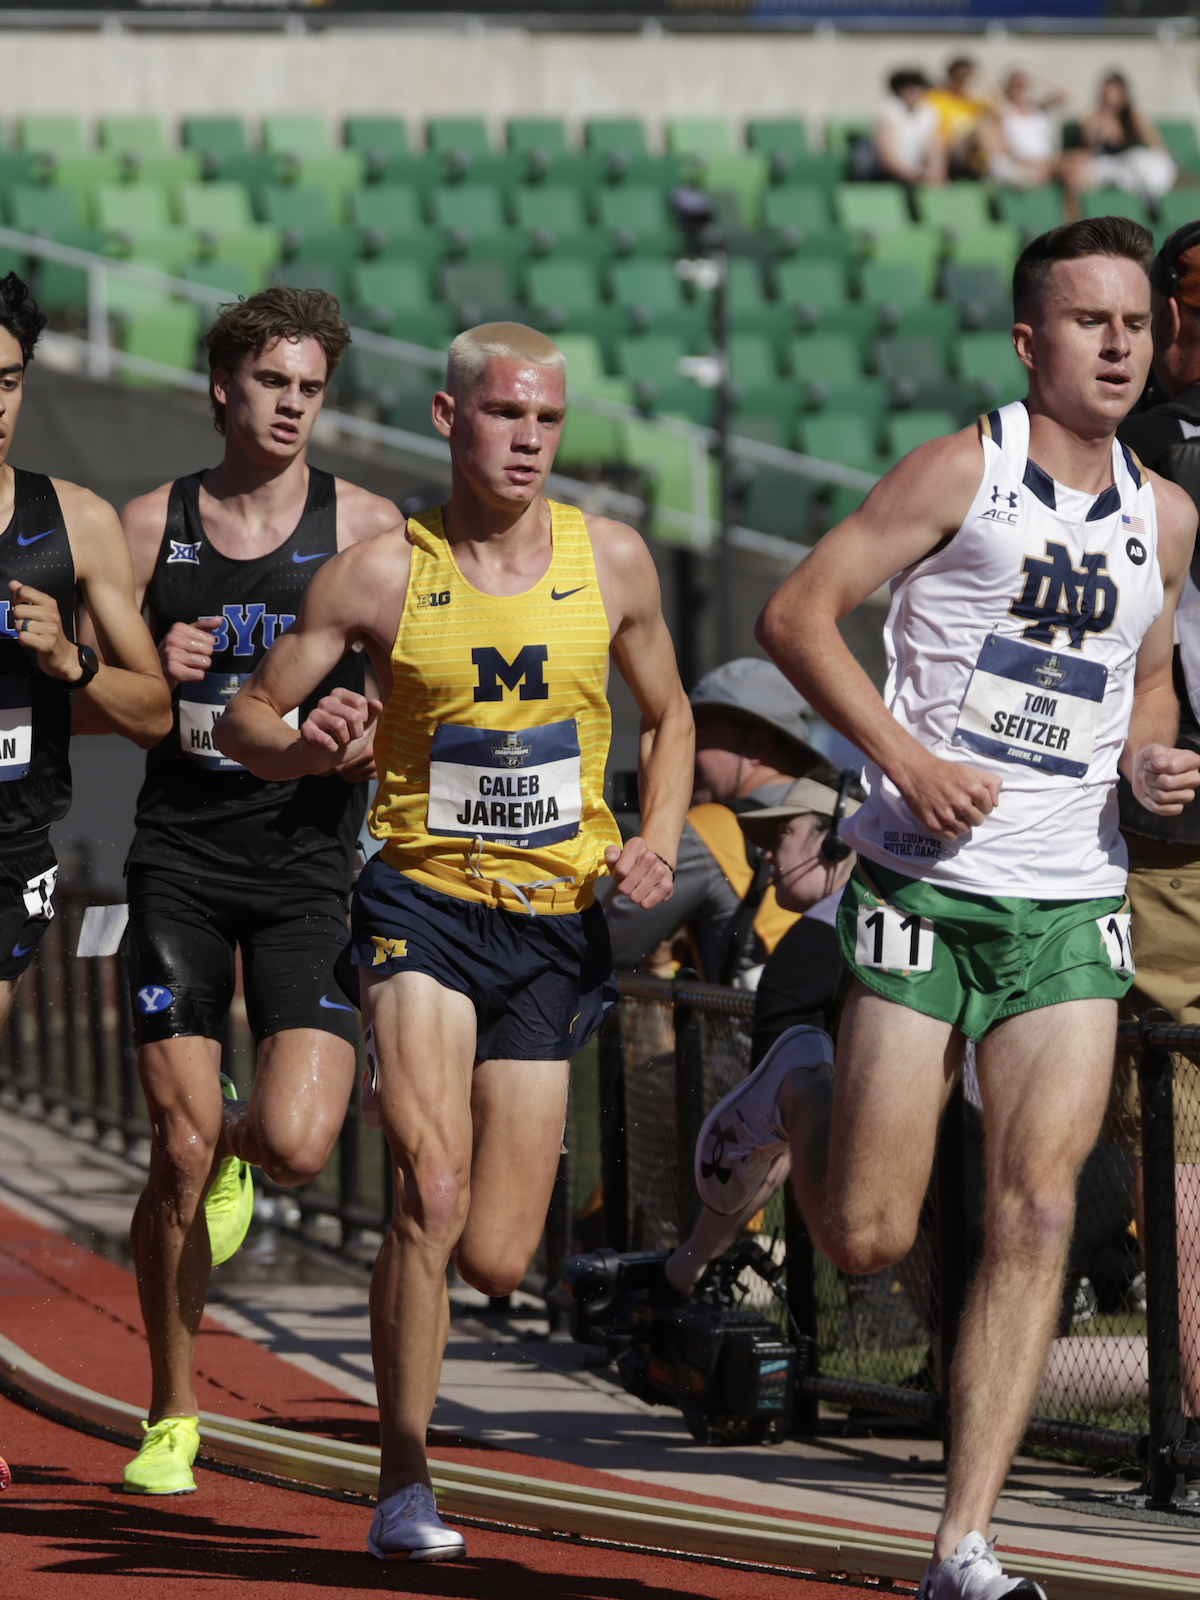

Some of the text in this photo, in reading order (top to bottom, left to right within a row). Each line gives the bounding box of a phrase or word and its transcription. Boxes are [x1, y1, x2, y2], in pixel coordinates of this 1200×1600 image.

[981, 508, 1019, 523] ACC
[170, 543, 200, 562] XII
[1129, 544, 1144, 558] AB
[471, 644, 548, 703] M
[1023, 692, 1058, 717] TOM
[191, 728, 216, 751] HA
[990, 711, 1071, 751] SEITZER
[479, 774, 540, 797] CALEB
[456, 796, 560, 829] JAREMA
[914, 845, 941, 859] DAME
[371, 935, 408, 967] M
[865, 911, 922, 966] 11
[138, 987, 165, 1012] Y
